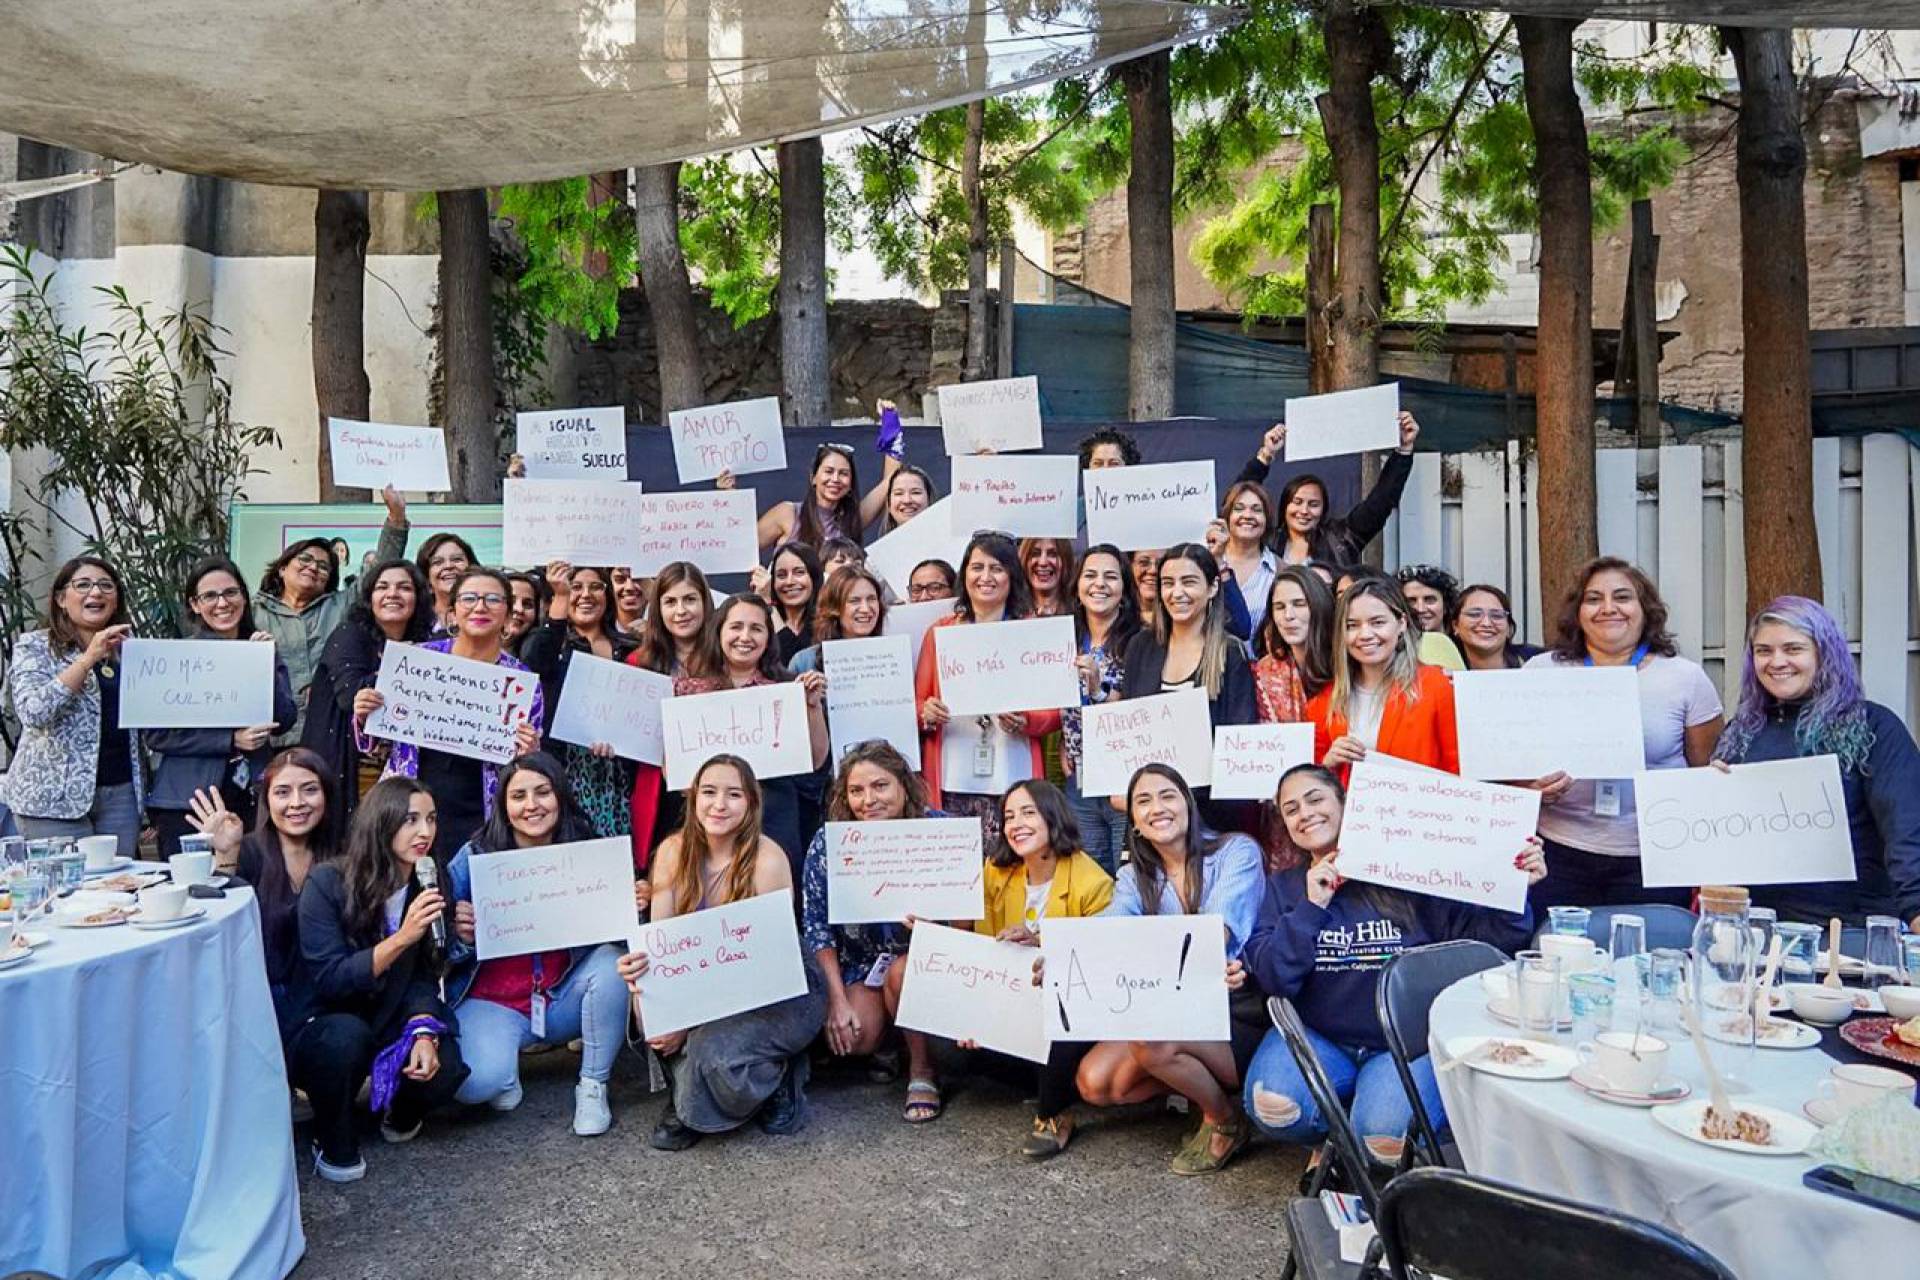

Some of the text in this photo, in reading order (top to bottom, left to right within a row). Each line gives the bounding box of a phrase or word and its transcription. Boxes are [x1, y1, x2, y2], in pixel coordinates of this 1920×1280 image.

[550, 418, 595, 432] IGUAL
[682, 411, 741, 441] AMOR
[1125, 487, 1156, 503] más
[1162, 703, 1172, 720] A
[1491, 791, 1525, 806] por
[1350, 799, 1365, 813] lo
[1408, 809, 1453, 823] somos
[1465, 814, 1480, 825] no
[1490, 818, 1517, 831] por
[1423, 830, 1477, 846] estamos
[1356, 920, 1402, 942] Hills
[699, 959, 709, 969] a
[716, 945, 748, 965] Casa
